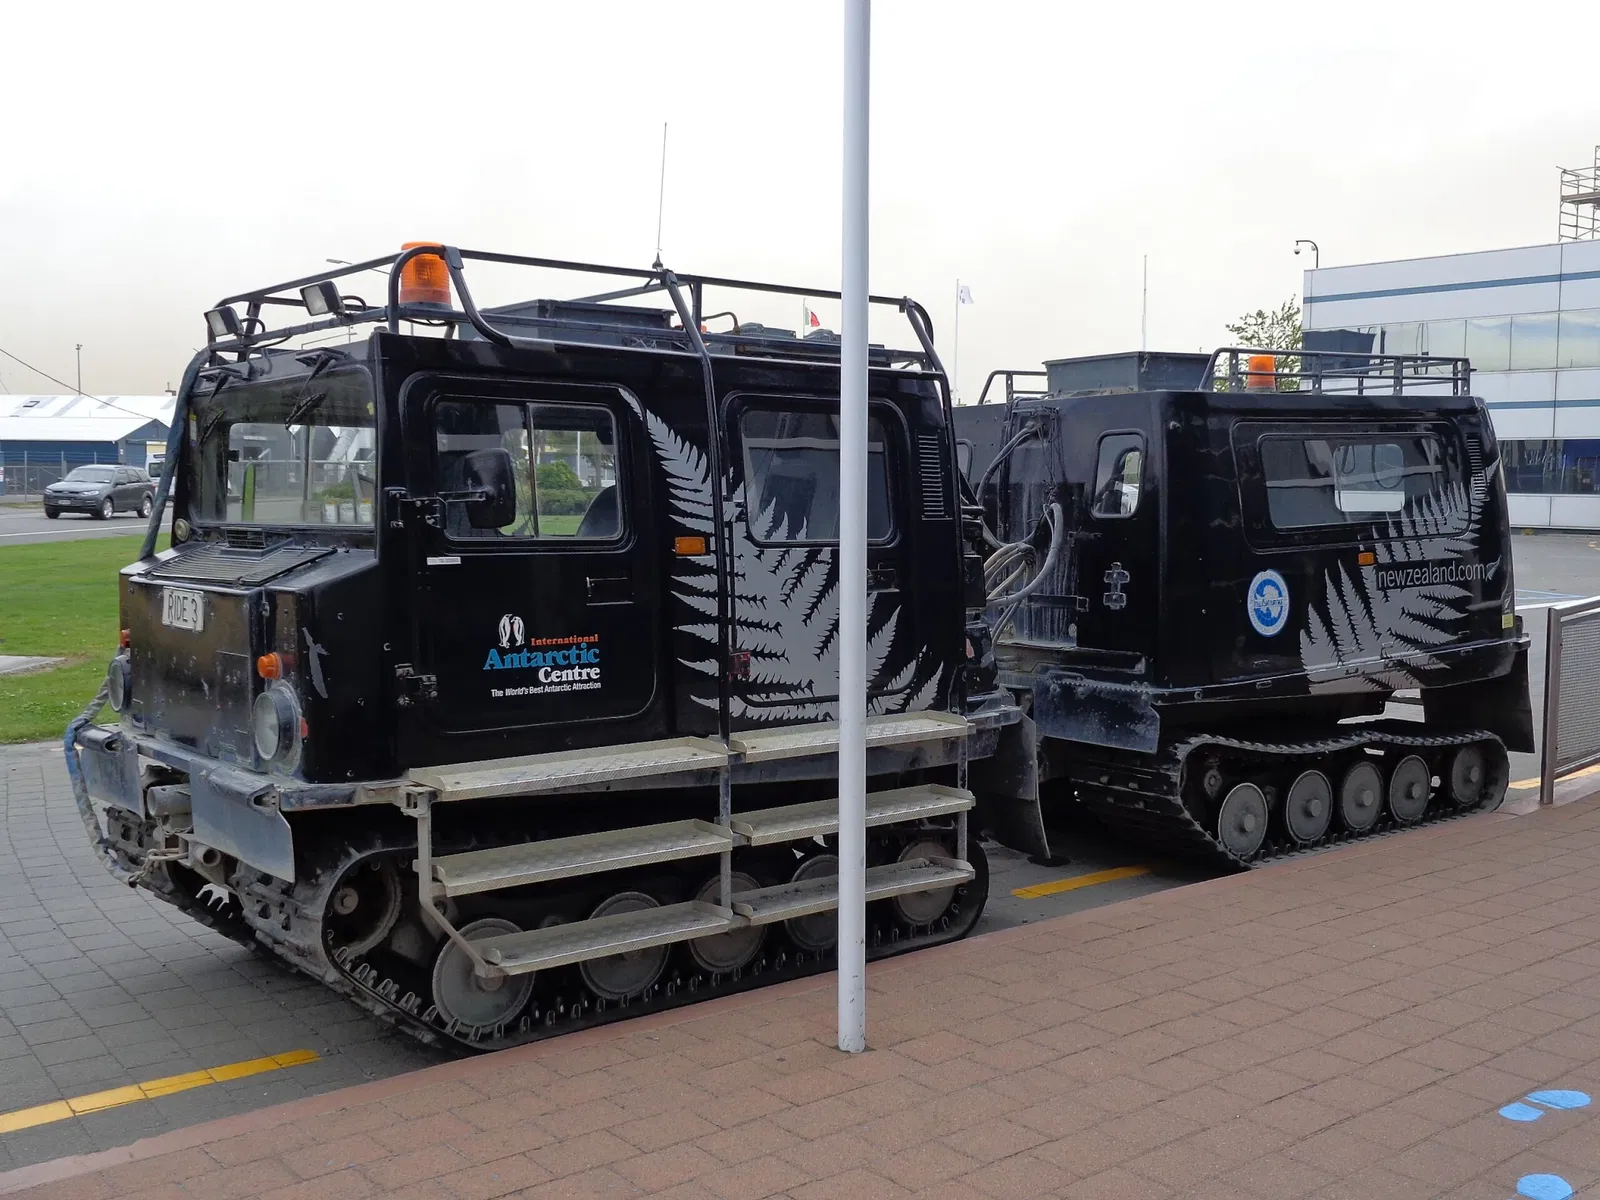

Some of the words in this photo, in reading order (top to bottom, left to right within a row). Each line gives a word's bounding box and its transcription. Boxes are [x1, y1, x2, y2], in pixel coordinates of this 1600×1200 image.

[1378, 560, 1485, 588] newzealand.com
[167, 593, 189, 623] RIDE
[530, 633, 599, 646] International
[482, 642, 601, 671] Antarctic
[538, 665, 601, 684] Centre
[490, 688, 504, 698] The
[504, 686, 529, 697] World's
[529, 685, 544, 695] Best
[544, 682, 572, 694] Antarctic
[572, 680, 602, 692] Attraction
